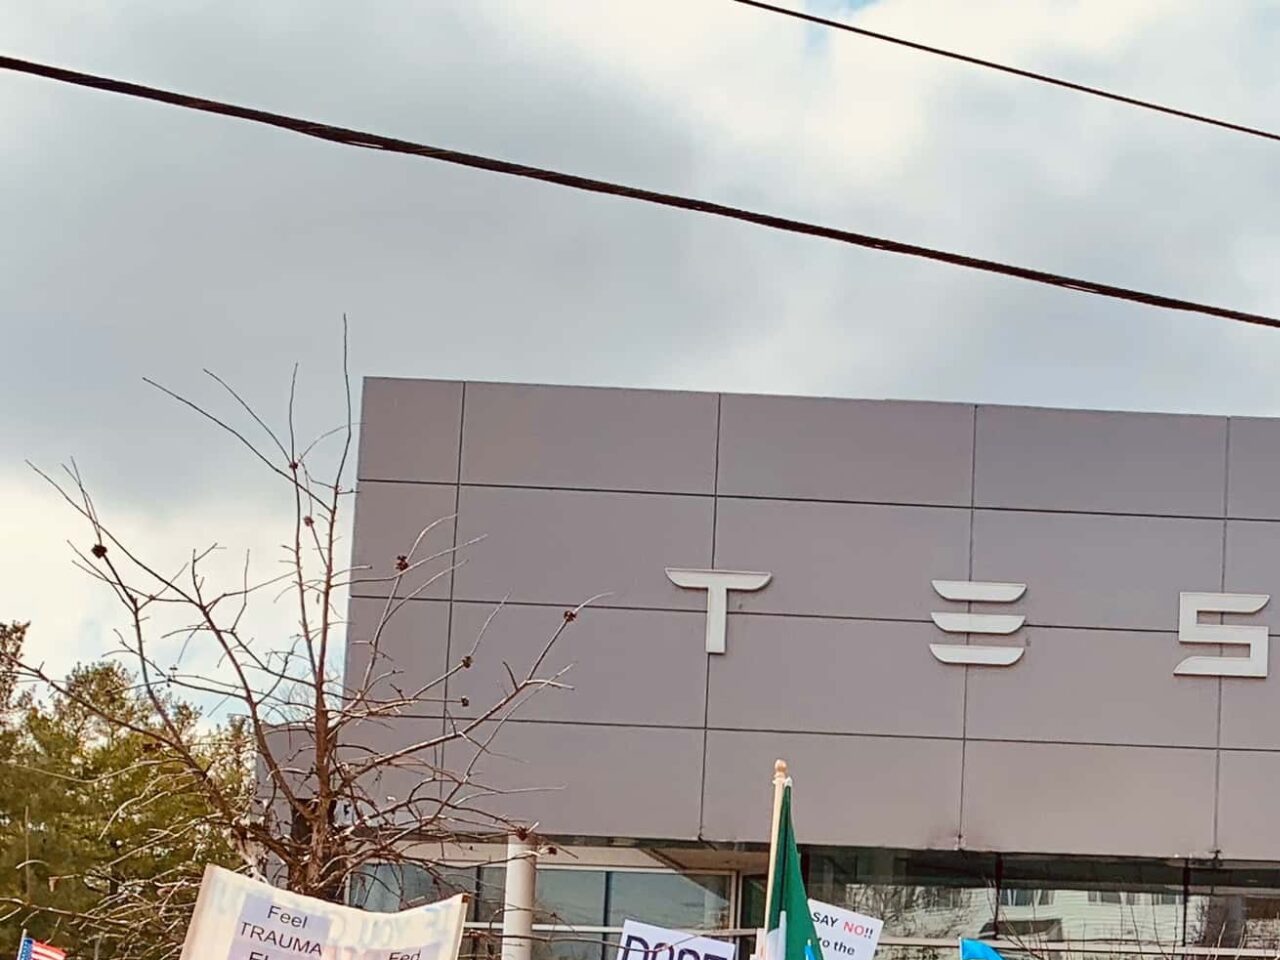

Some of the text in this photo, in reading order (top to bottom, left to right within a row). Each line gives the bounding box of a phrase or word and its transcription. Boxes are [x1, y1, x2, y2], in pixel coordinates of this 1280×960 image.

[267, 905, 308, 929] Feel
[812, 912, 873, 939] SAY NO!!
[240, 921, 322, 957] TRAUMA
[833, 942, 855, 955] the
